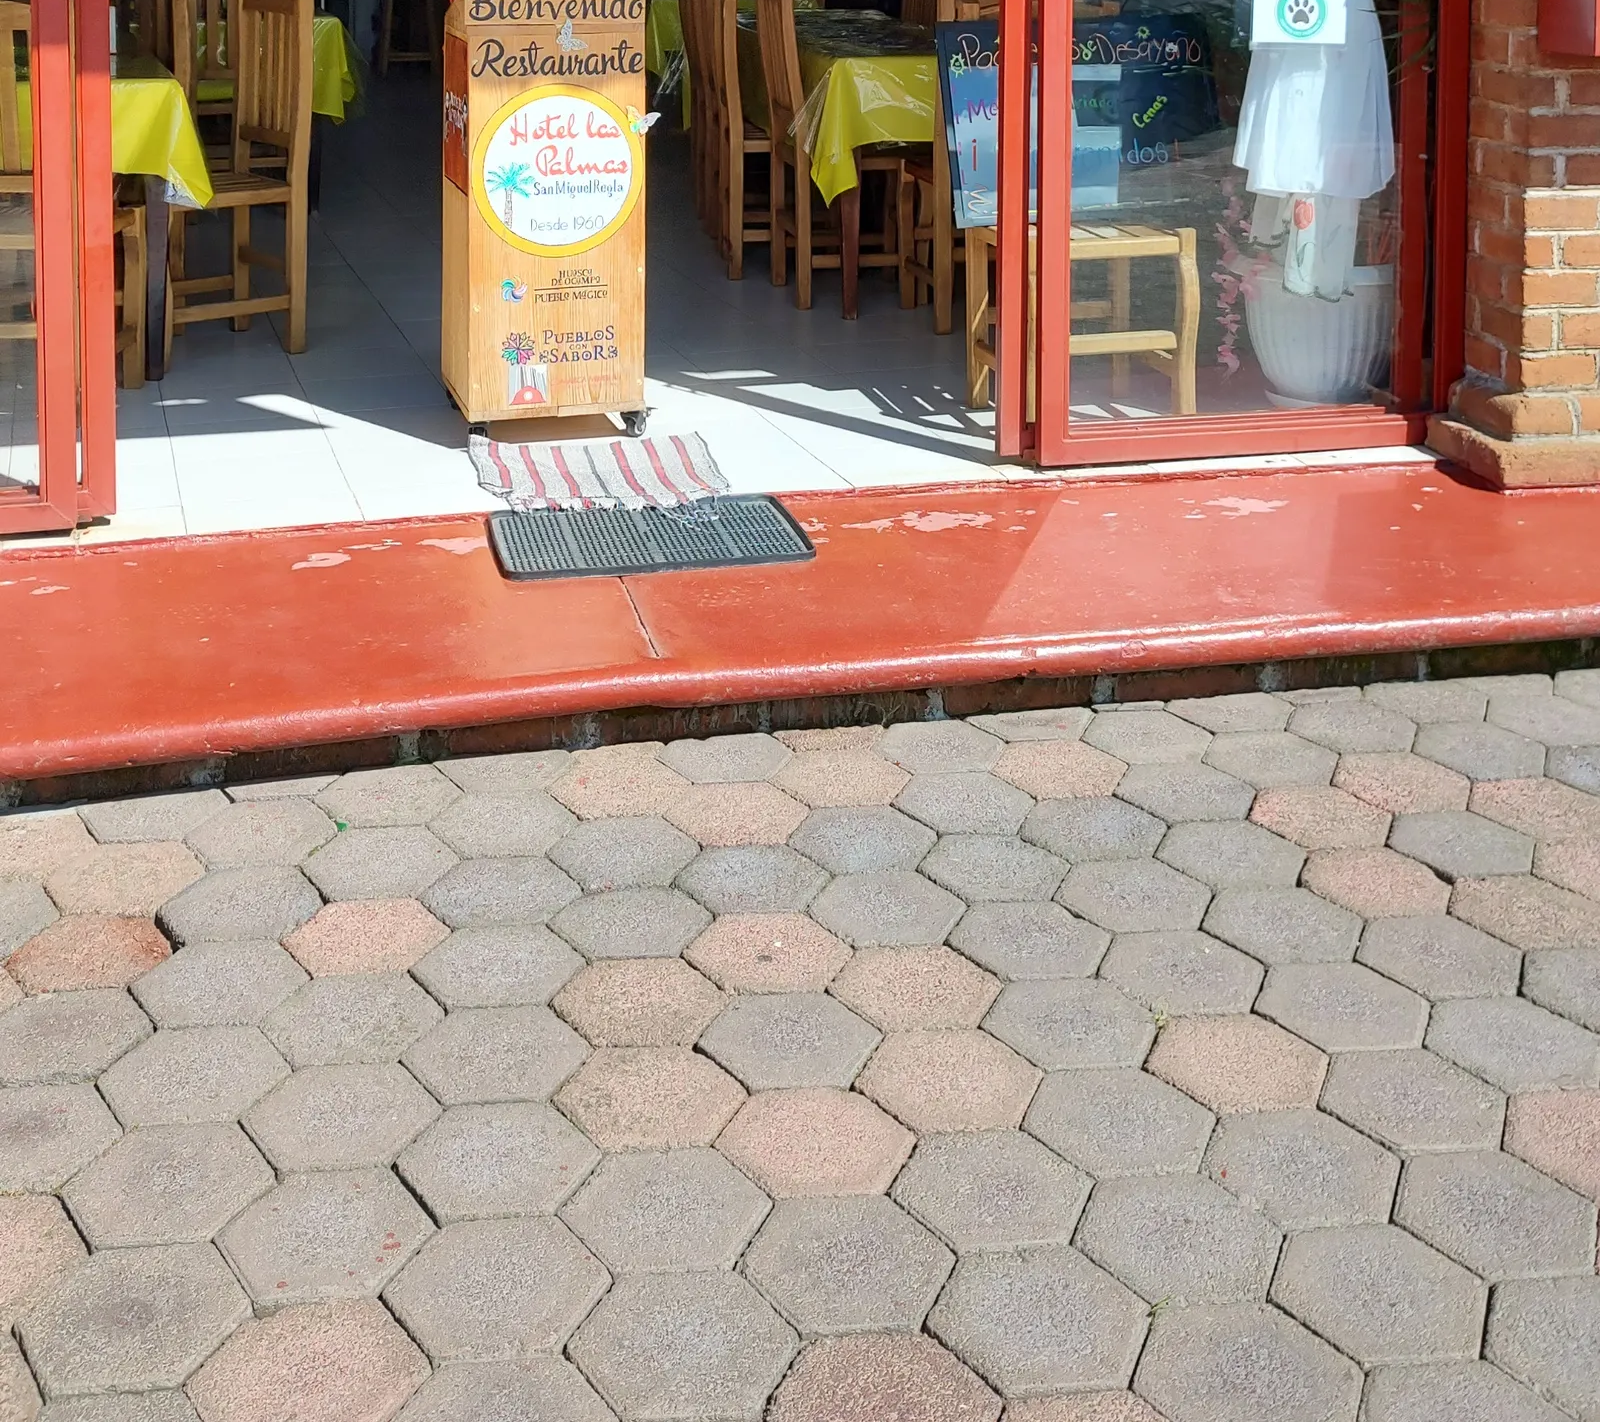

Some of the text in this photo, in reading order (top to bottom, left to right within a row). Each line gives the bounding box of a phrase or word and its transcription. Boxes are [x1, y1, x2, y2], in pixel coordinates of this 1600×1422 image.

[471, 39, 644, 77] Restaurante
[1132, 95, 1168, 128] Cenas
[510, 113, 579, 146] Hotel
[535, 145, 630, 176] Palmas
[533, 179, 624, 199] San Miguel Regla
[530, 215, 604, 232] Desde 1960
